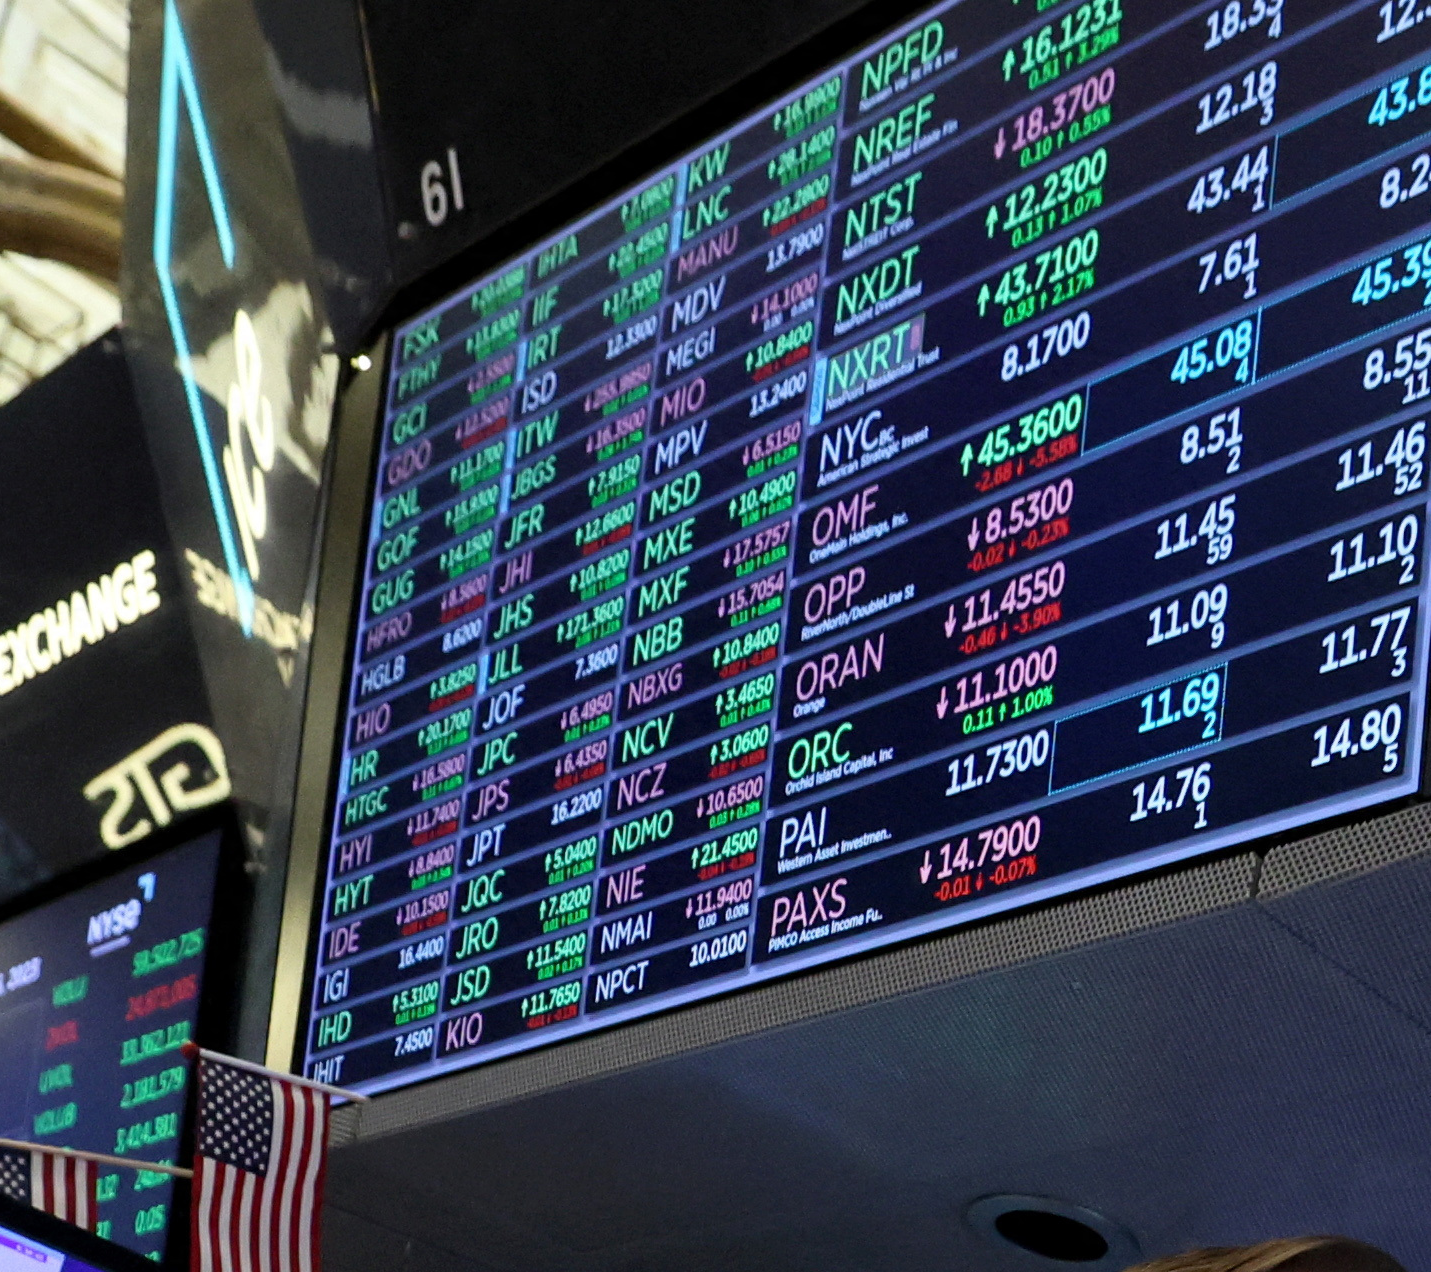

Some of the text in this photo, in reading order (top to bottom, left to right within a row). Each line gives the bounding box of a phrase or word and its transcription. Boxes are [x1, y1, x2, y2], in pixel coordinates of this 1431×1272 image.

[1197, 62, 1278, 133] 12.18
[845, 173, 922, 245] NTST
[836, 248, 919, 322] NXDT
[827, 321, 1253, 395] NXRT 45.08
[819, 410, 1427, 491] NYC 11.46
[812, 486, 1237, 560] OMF 11.45
[805, 566, 867, 624] OPP
[797, 608, 1412, 712] ORAN 11.1000 11.77
[476, 732, 519, 775] JPC
[788, 722, 853, 780] ORC
[612, 811, 759, 867] NDMO 21.4500
[779, 806, 827, 858] PAI
[333, 876, 374, 916] HYT
[460, 871, 506, 914] JQC
[771, 815, 1043, 937] PAXS 14.7900
[601, 911, 748, 967] NMAI 10.0100
[595, 961, 650, 1003] NPCT
[318, 1010, 353, 1047] IHD
[446, 1014, 484, 1051] KIO
